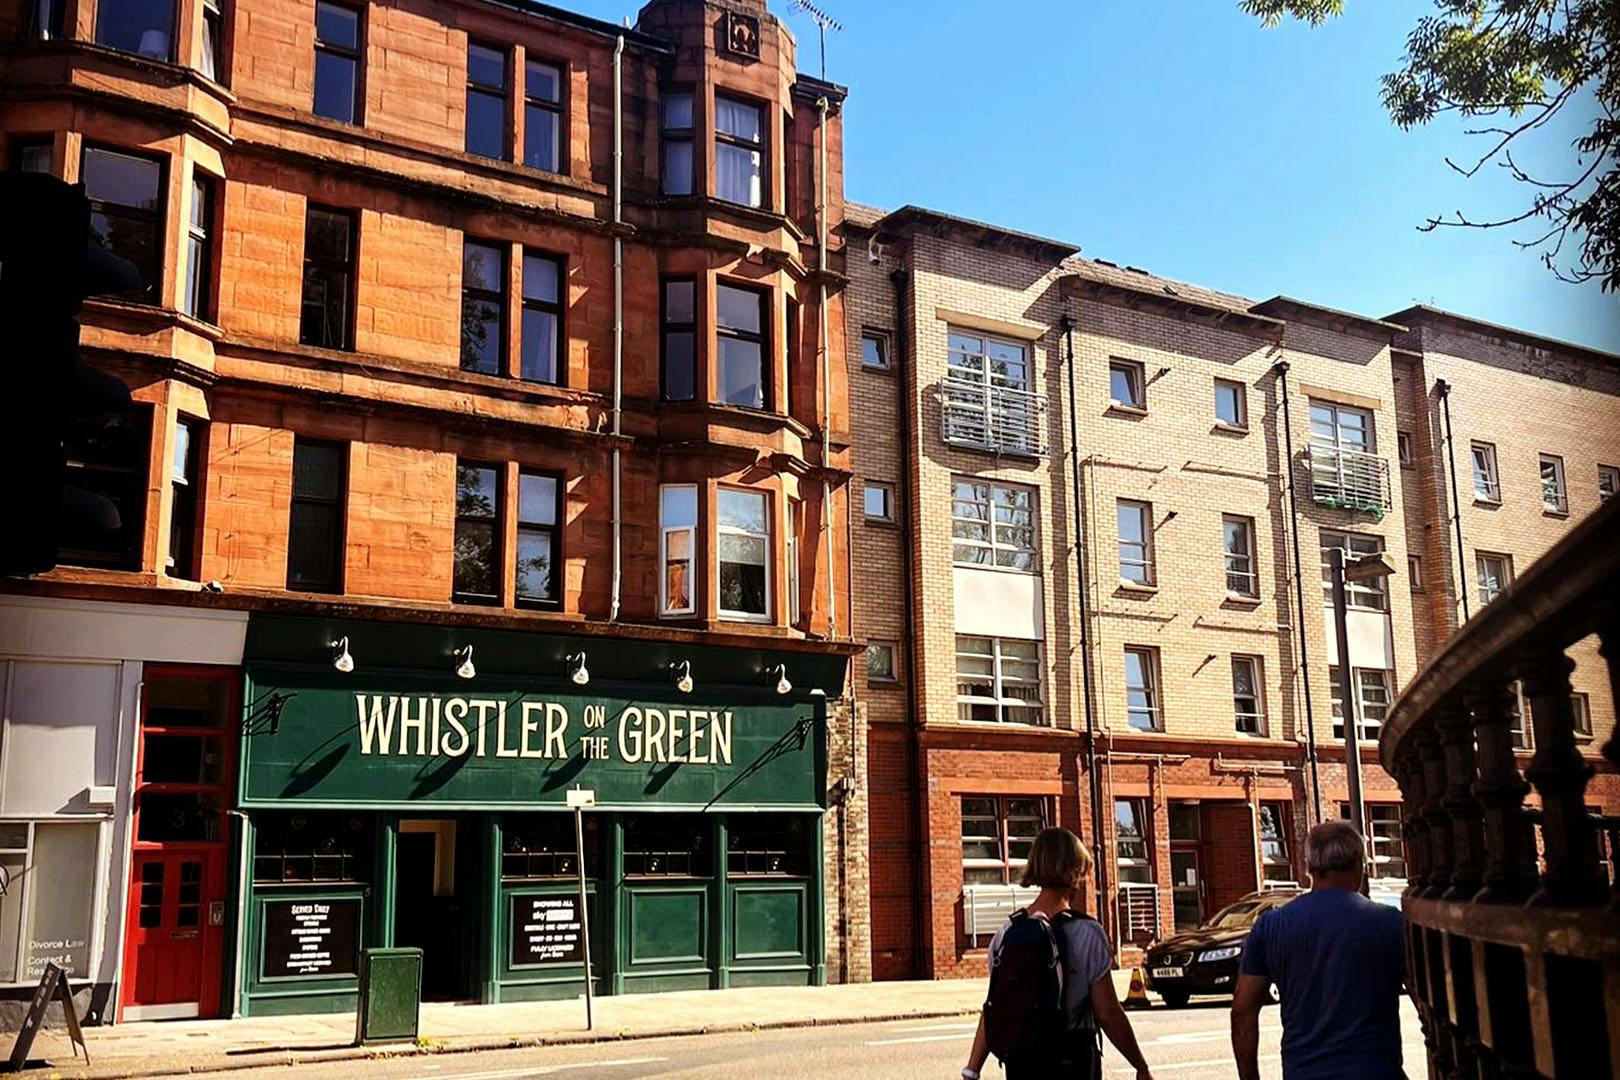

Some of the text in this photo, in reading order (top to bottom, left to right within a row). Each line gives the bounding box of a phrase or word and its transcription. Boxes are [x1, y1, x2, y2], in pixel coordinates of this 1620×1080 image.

[355, 694, 733, 765] WHISTLER ON THE GREEN
[28, 940, 63, 949] Divorce
